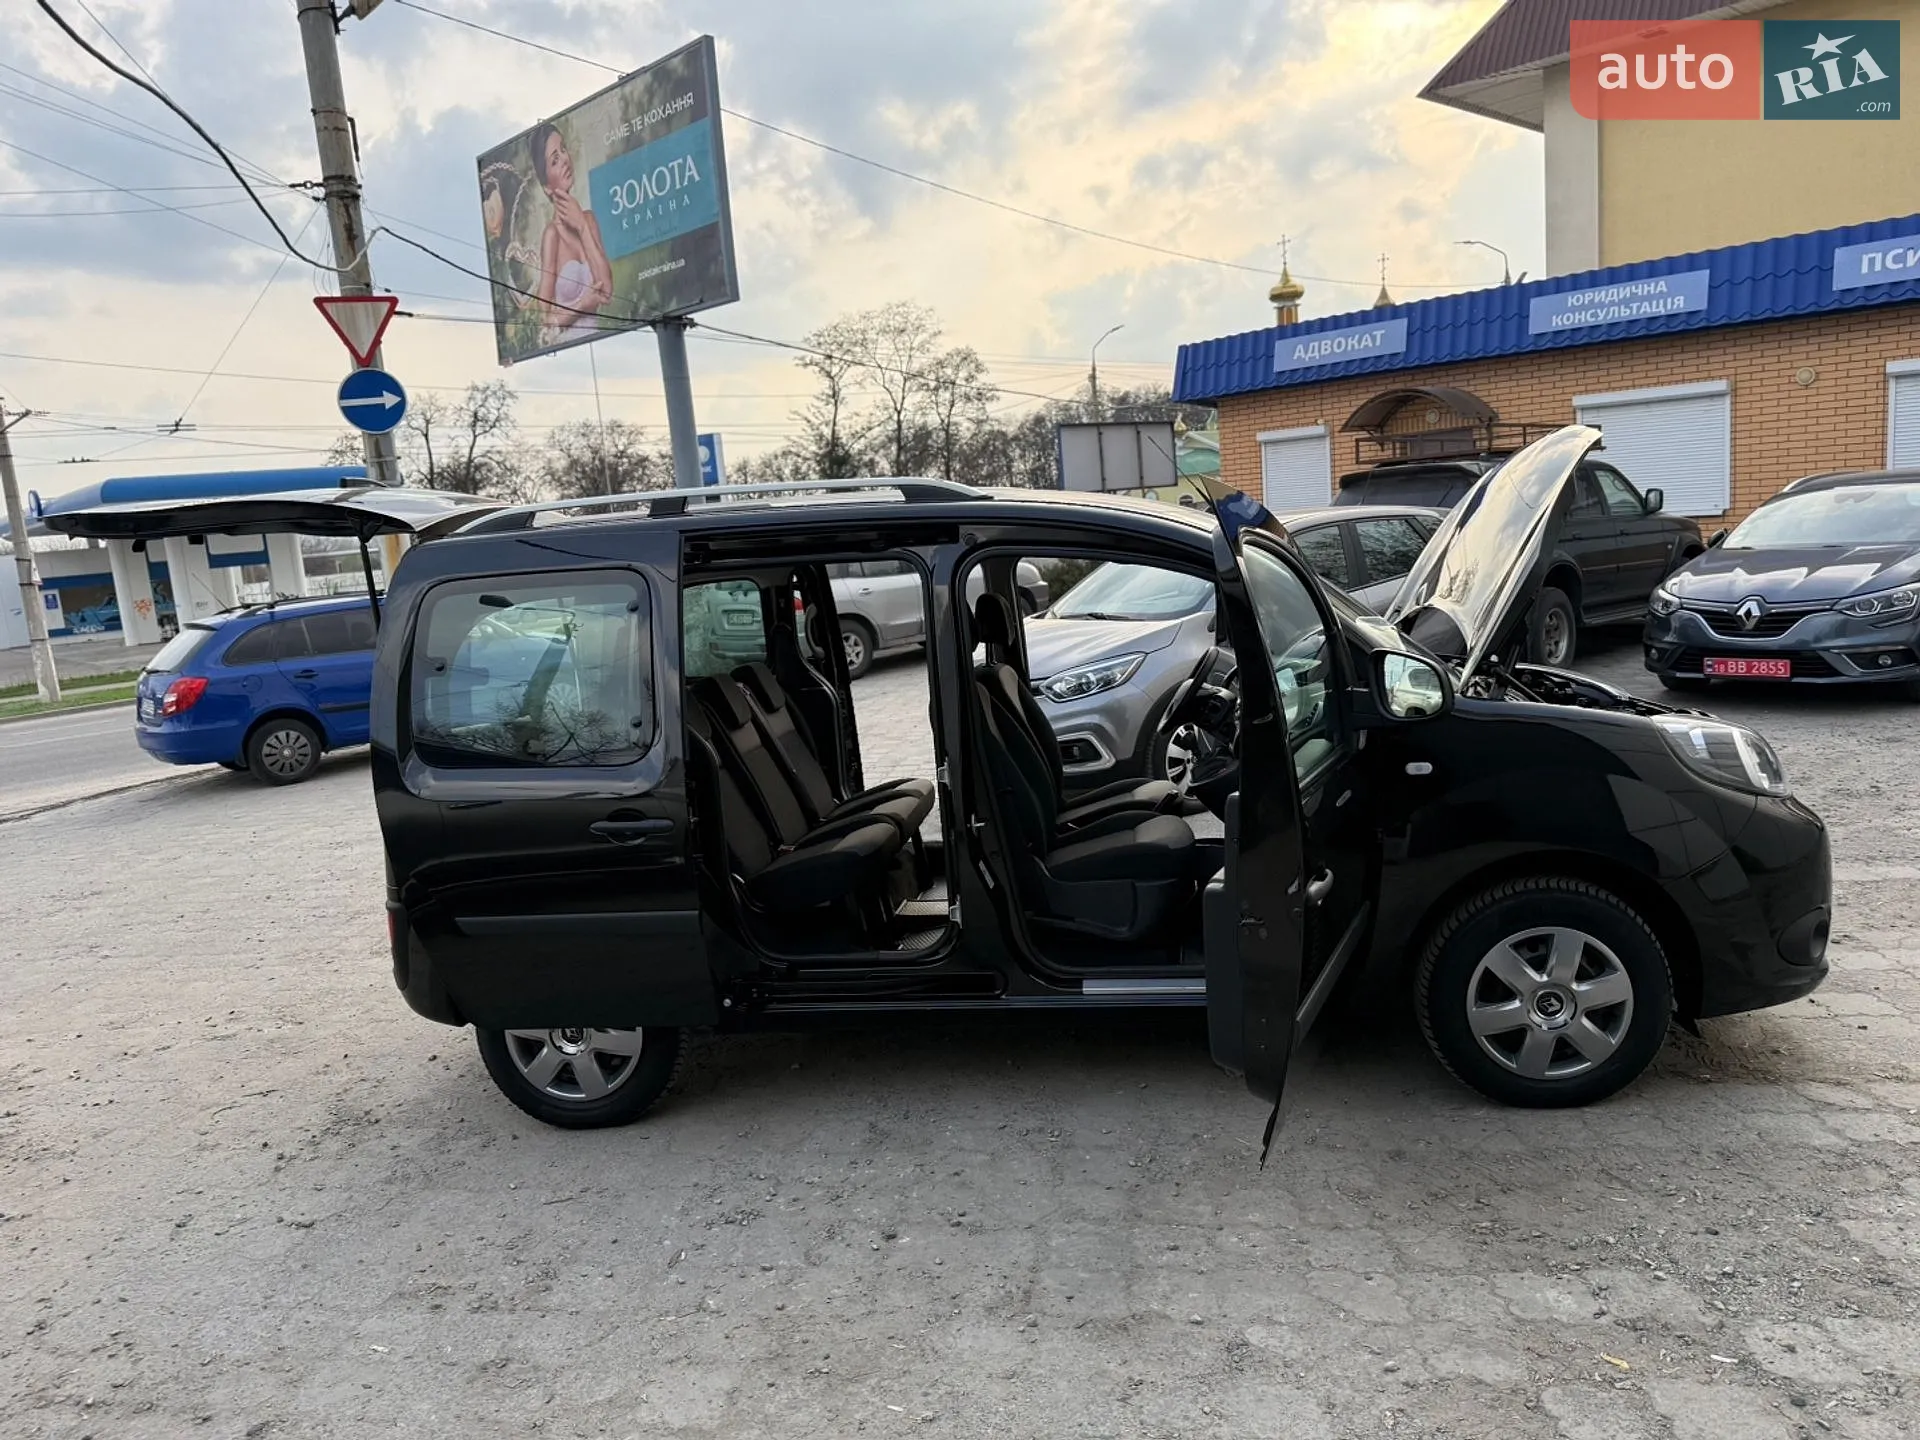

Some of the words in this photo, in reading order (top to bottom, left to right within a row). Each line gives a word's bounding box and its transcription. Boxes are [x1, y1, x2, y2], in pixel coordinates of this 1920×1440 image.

[603, 122, 630, 145] САМЕ
[631, 115, 643, 132] ТЕ
[643, 91, 694, 126] КОХАННЯ
[609, 154, 701, 215] ЗОЛОТА
[1567, 280, 1668, 307] ЮРИДИЧНА
[1551, 295, 1685, 327] КОНСУЛЬТАЦІЯ
[1293, 330, 1385, 361] АДВОКАТ
[1751, 661, 1785, 674] 2855
